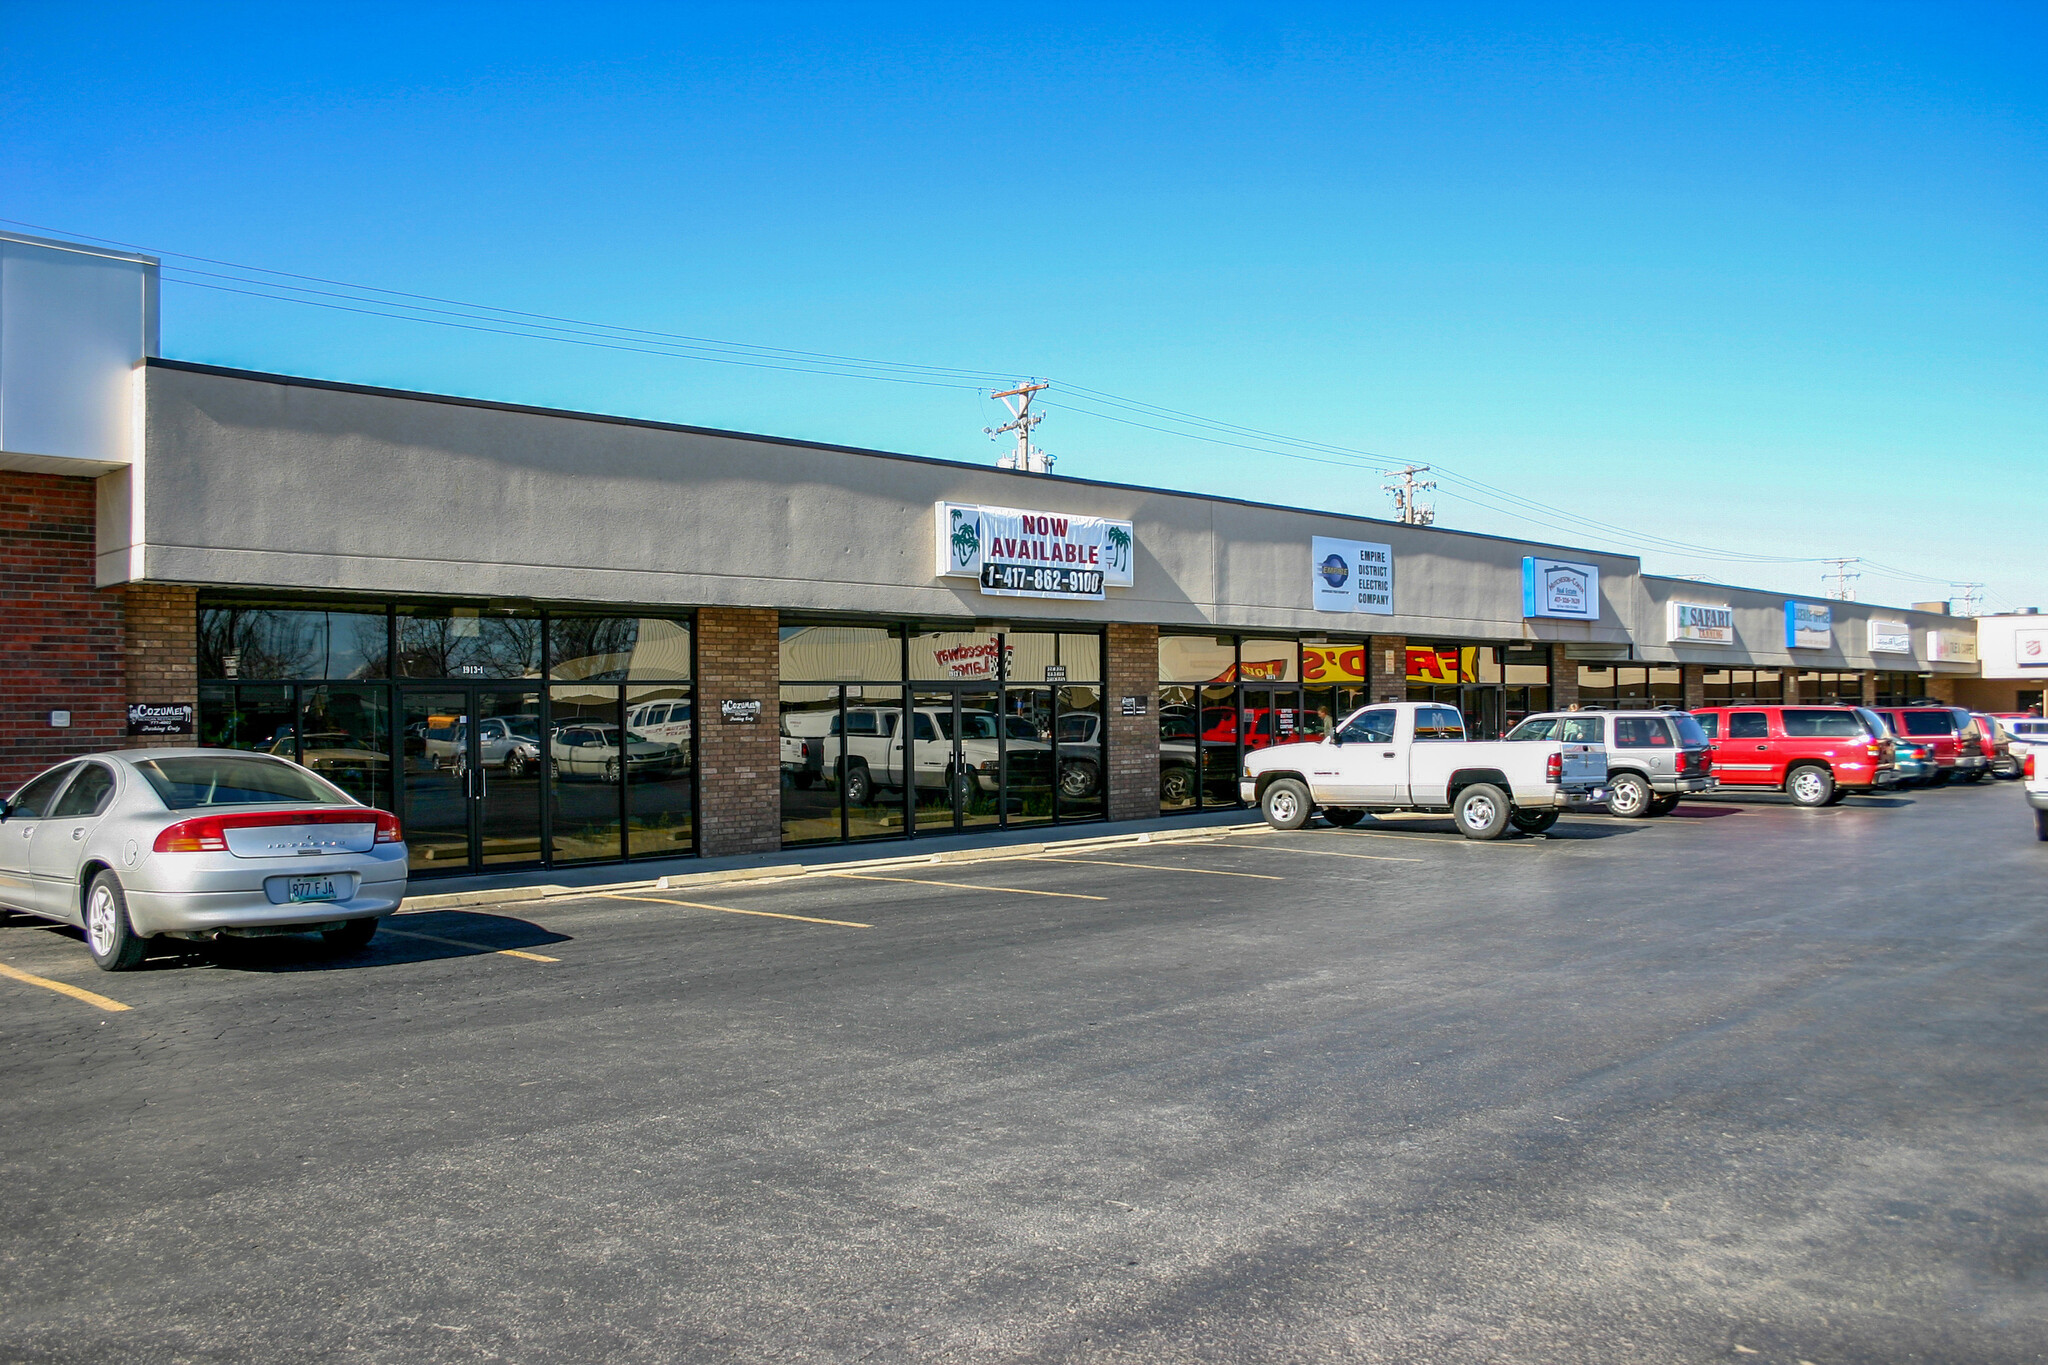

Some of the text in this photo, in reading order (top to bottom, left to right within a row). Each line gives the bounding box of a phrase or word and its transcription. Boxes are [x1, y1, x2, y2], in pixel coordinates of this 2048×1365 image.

[1022, 514, 1069, 538] NOW
[991, 537, 1099, 565] AVAILABLE
[1360, 549, 1386, 563] EMPIRE
[1323, 566, 1348, 576] EMPIRE
[1359, 564, 1387, 577] DISTRICT
[988, 565, 1100, 592] 1-417-862-9100
[1359, 579, 1388, 591] ELECTRIC
[1358, 592, 1389, 605] COMPANY
[1690, 608, 1730, 628] SAFARI
[137, 704, 184, 717] COZUMEL
[292, 883, 311, 897] 877
